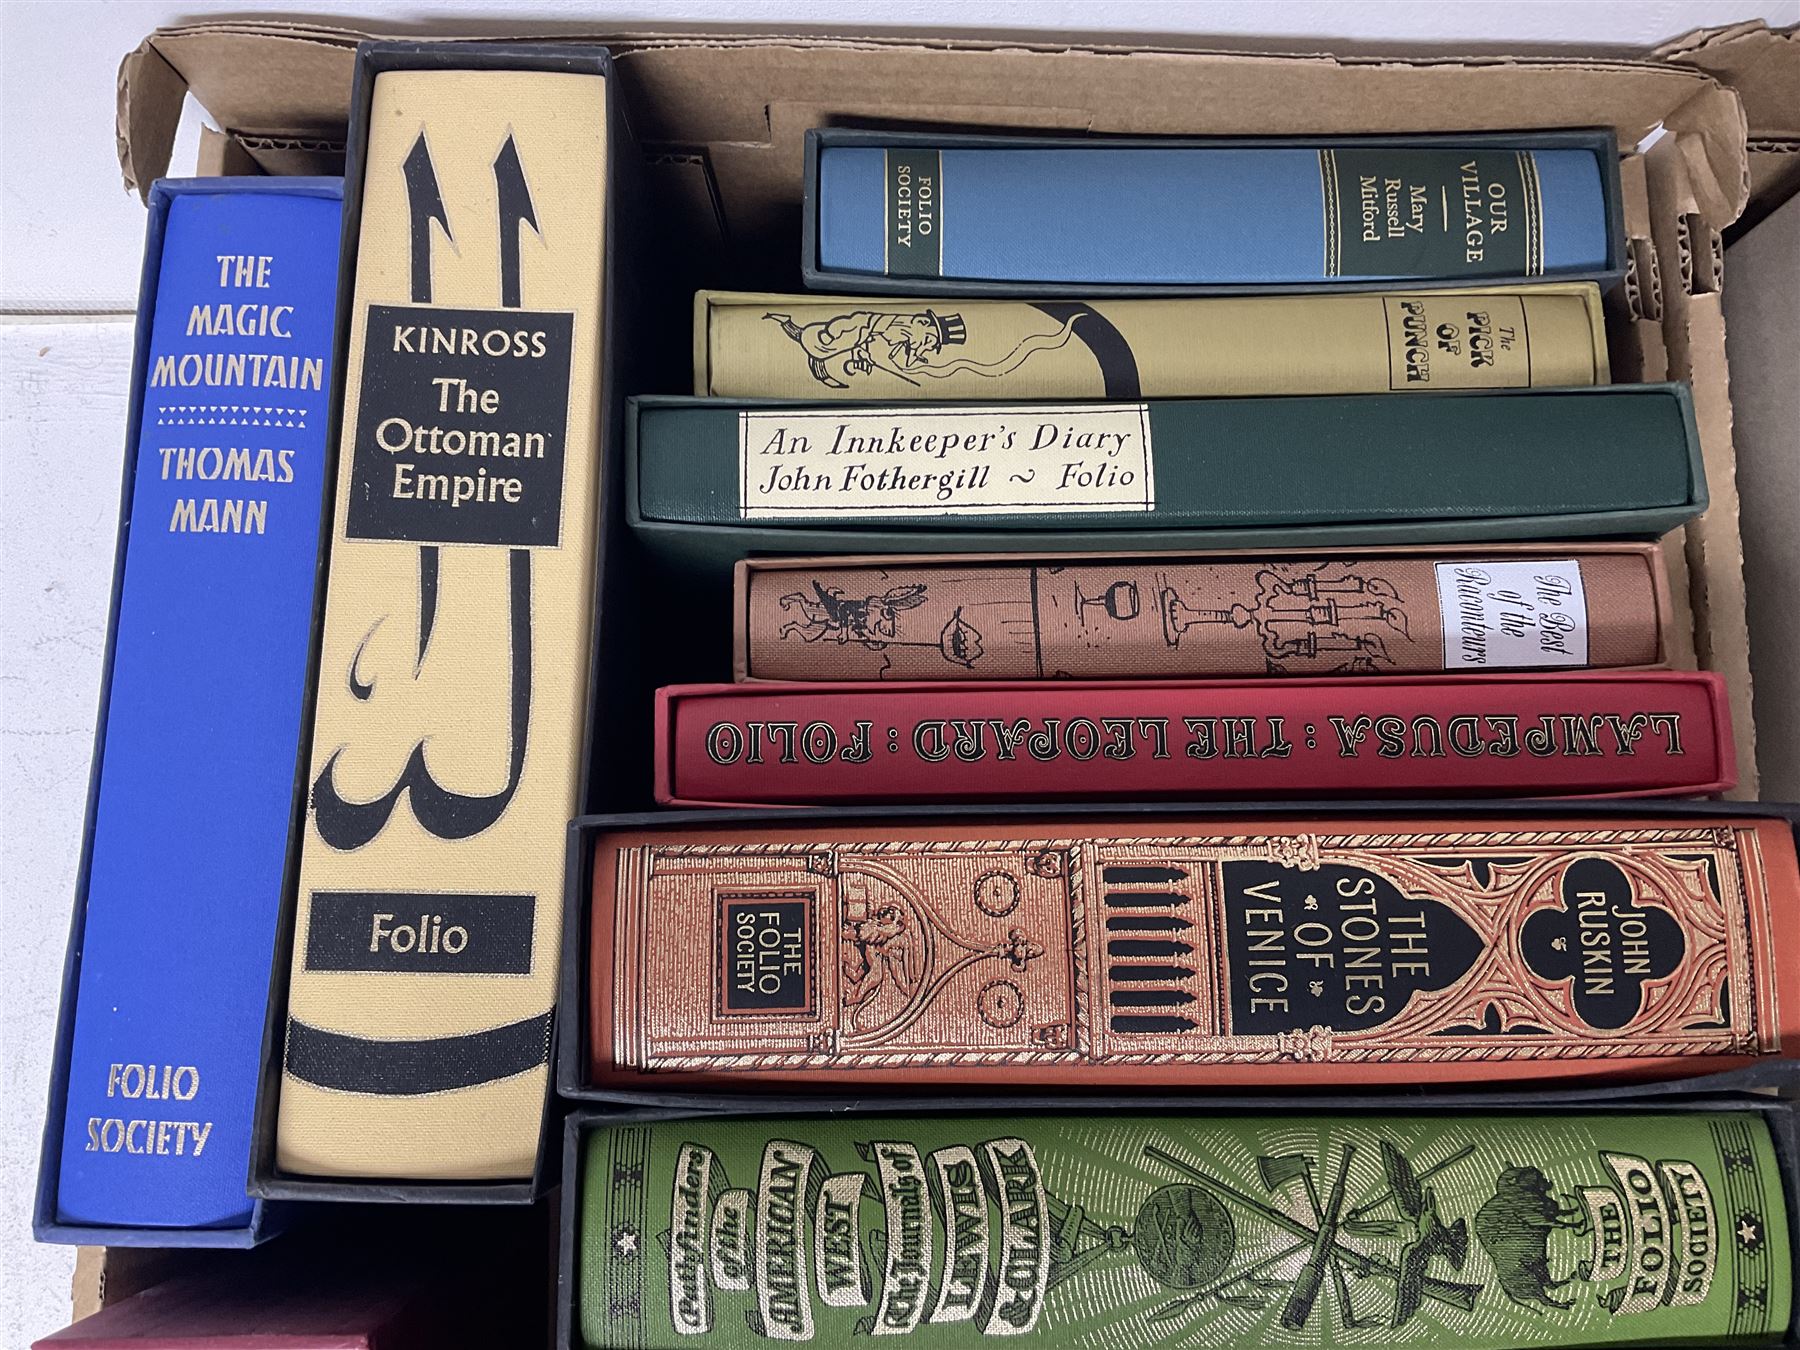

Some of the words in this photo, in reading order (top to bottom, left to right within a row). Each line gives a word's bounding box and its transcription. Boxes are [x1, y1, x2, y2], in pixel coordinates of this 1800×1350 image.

[897, 165, 912, 248] SOCIETY
[918, 176, 933, 237] FOLIO
[1359, 175, 1381, 242] Mitford
[1384, 178, 1405, 239] Russell
[1405, 185, 1428, 234] Mary
[1460, 160, 1484, 263] VILLAGE
[1487, 183, 1508, 235] OUR
[216, 255, 274, 289] THE
[185, 304, 294, 339] MAGIC
[393, 325, 547, 358] KINROSS
[1400, 301, 1430, 382] PUNCH
[1436, 323, 1461, 356] OF
[1466, 311, 1494, 368] PICK
[1499, 326, 1516, 351] The
[150, 353, 323, 391] MOUNTAIN
[432, 377, 500, 414] The
[376, 417, 546, 459] Ottoman
[760, 427, 812, 456] An
[825, 423, 1018, 459] Innkeeper's
[1029, 423, 1132, 458] Diary
[159, 447, 295, 484] THOMAS
[393, 463, 523, 508] Empire
[759, 464, 833, 493] John
[838, 463, 990, 500] Fothergill
[1056, 461, 1135, 490] Folio
[168, 499, 268, 535] MANN
[1487, 589, 1535, 611] of
[1533, 575, 1573, 607] The
[1454, 567, 1494, 664] Raconteurs
[1499, 612, 1536, 638] the
[1539, 612, 1576, 655] Best
[706, 719, 876, 766] FOLIO
[912, 716, 1172, 763] LEOPARD
[1183, 716, 1294, 761] THE
[1328, 713, 1686, 759] LAMPEDUSA
[369, 913, 469, 955] Folio
[736, 912, 756, 993] SOCIETY
[758, 912, 781, 995] FOLIO
[783, 927, 802, 976] THE
[1243, 880, 1289, 1015] VENICE
[1294, 921, 1334, 970] OF
[1336, 877, 1385, 1017] STONES
[1387, 910, 1431, 979] THE
[1575, 890, 1614, 996] RUSKIN
[1613, 905, 1651, 976] JOHN
[107, 1063, 200, 1102] FOLIO
[85, 1117, 213, 1158] SOCIETY
[881, 1148, 915, 1172] of
[674, 1149, 705, 1327] Pathfinders
[715, 1206, 739, 1249] the
[767, 1149, 803, 1333] AMERICAN
[889, 1176, 927, 1277] Journals
[943, 1160, 981, 1310] LEWIS
[993, 1145, 1040, 1290] CLARK
[1599, 1202, 1621, 1268] THE
[1626, 1168, 1663, 1296] FOLIO
[1670, 1170, 1708, 1293] SOCIETY
[718, 1249, 747, 1279] of
[823, 1190, 852, 1295] WEST
[999, 1289, 1037, 1328] &
